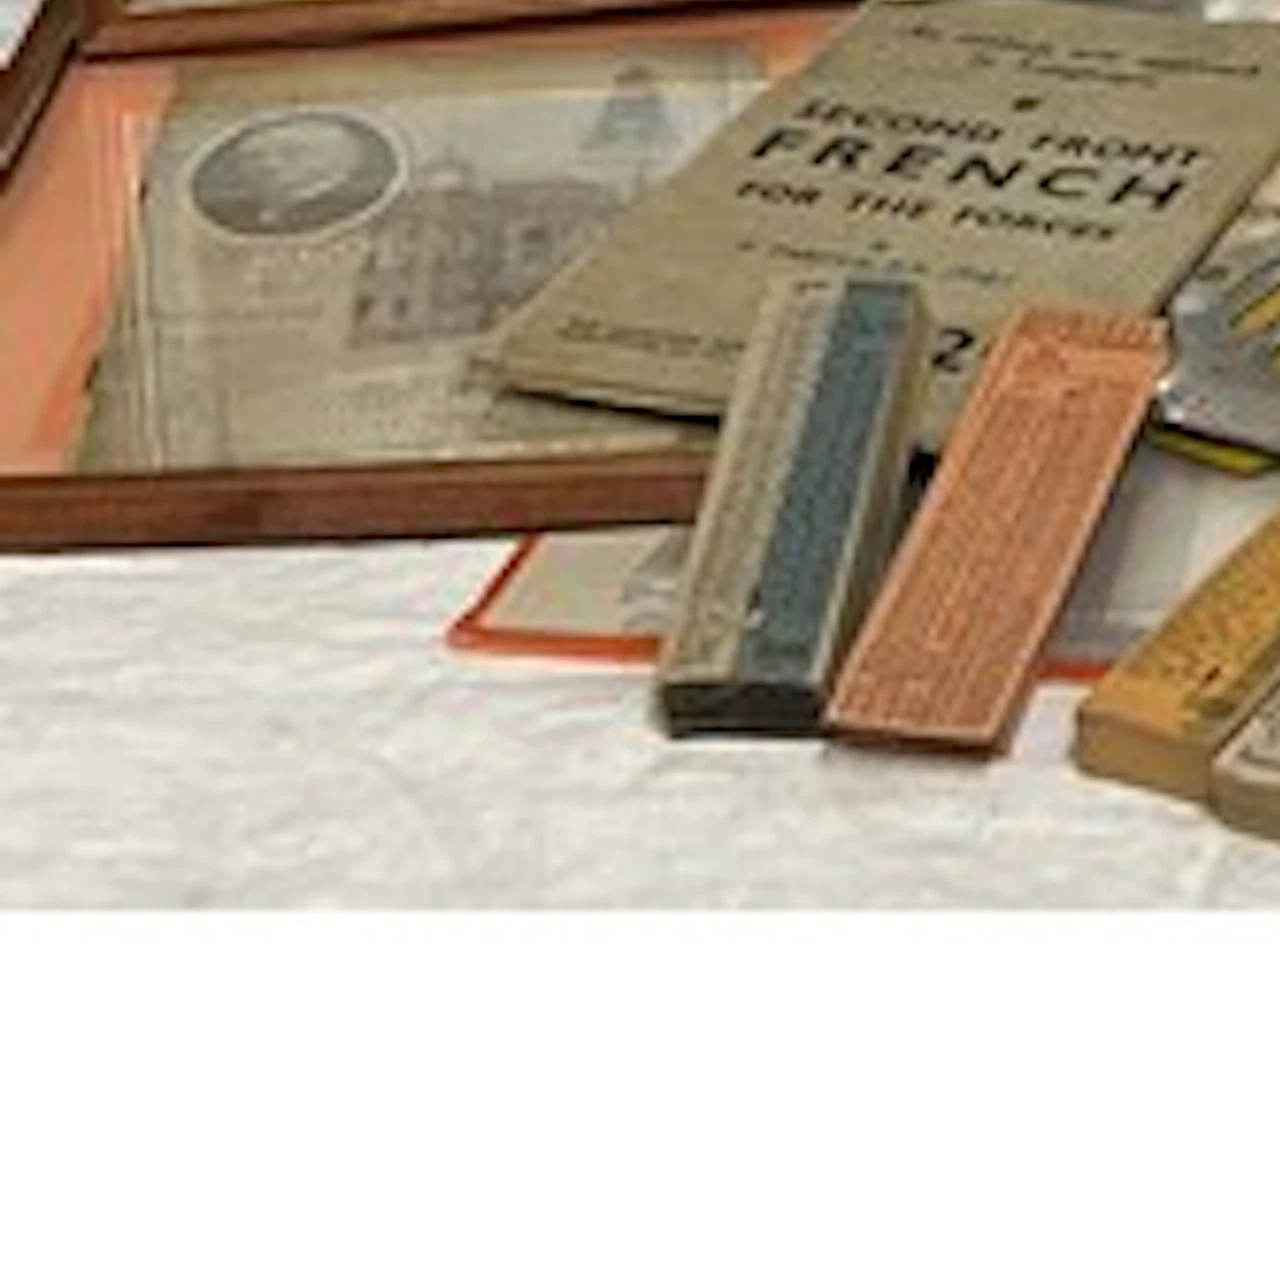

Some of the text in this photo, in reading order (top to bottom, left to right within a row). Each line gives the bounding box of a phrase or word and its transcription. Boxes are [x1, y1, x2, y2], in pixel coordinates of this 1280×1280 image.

[749, 127, 1187, 213] FRENCH
[796, 97, 1203, 170] SECOND FRONT
[735, 179, 1118, 243] FOR THE FORCES
